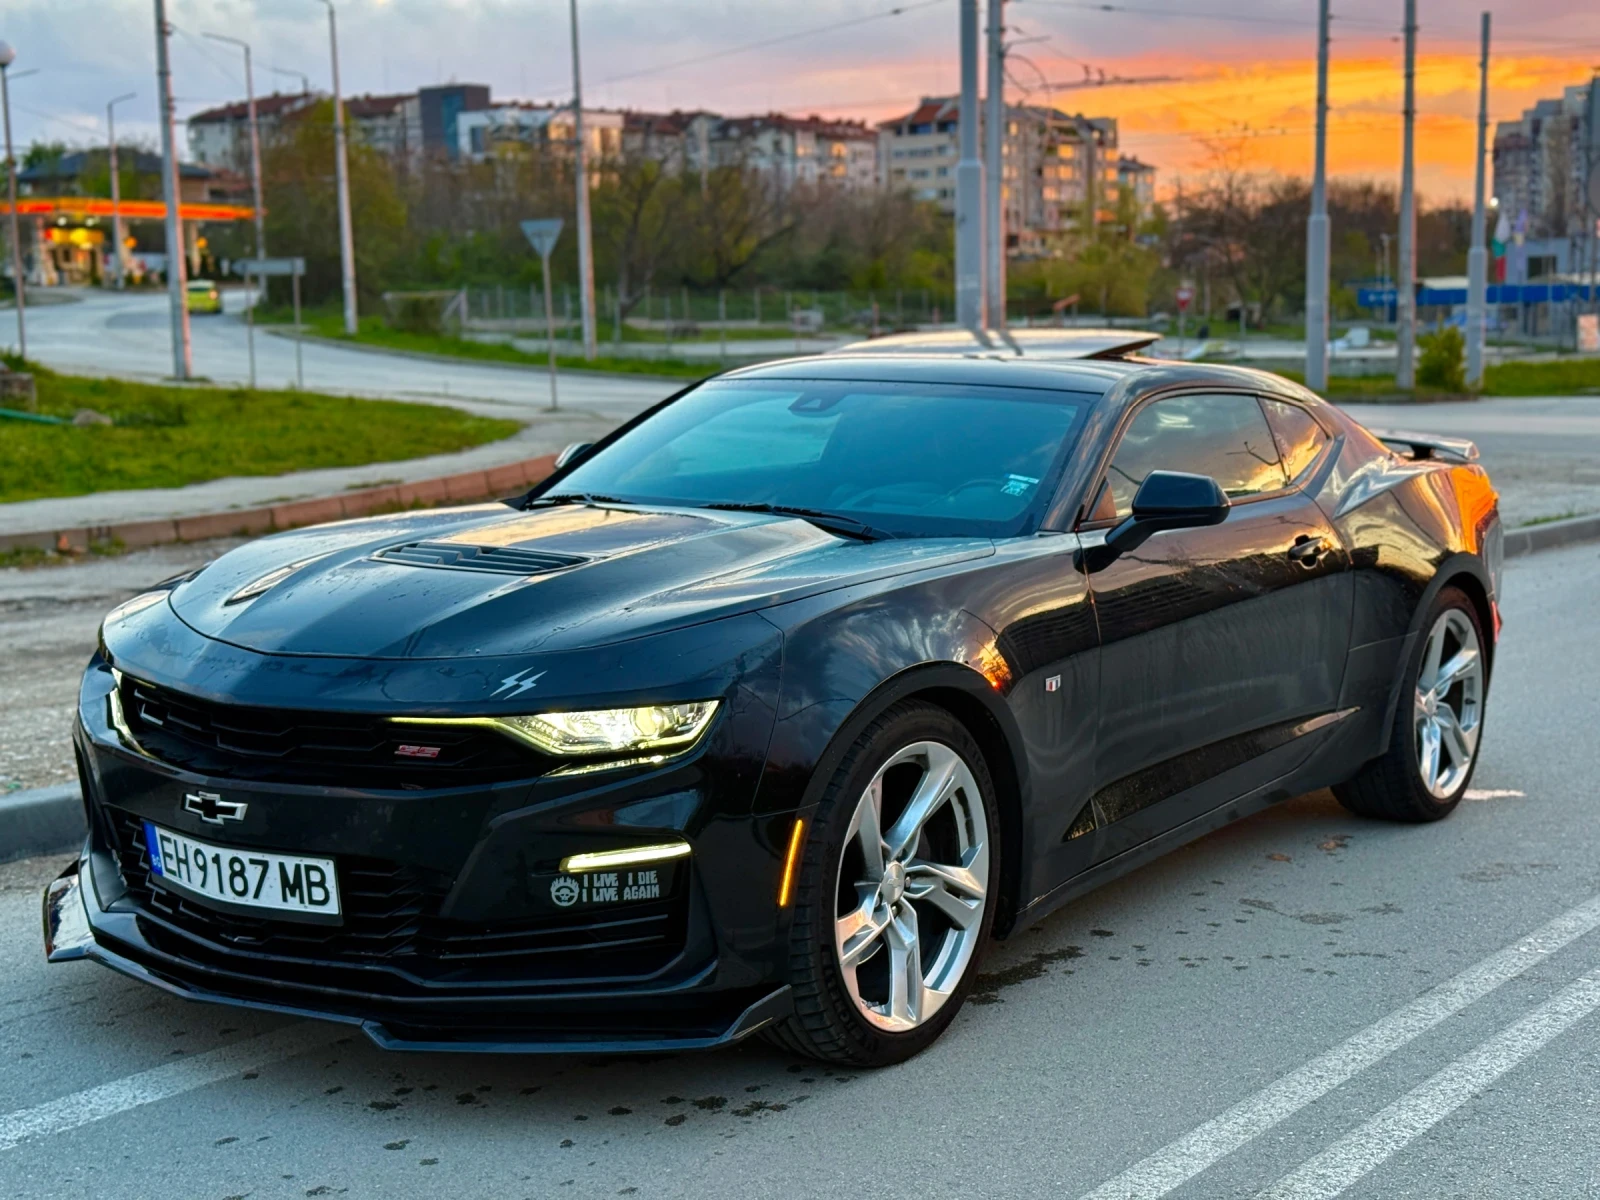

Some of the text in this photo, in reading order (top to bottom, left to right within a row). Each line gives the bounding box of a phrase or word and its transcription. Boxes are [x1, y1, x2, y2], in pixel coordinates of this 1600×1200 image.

[278, 861, 330, 906] MB
[583, 871, 658, 887] I LIVE I DIE
[582, 885, 659, 903] I LIVE AGAIN
